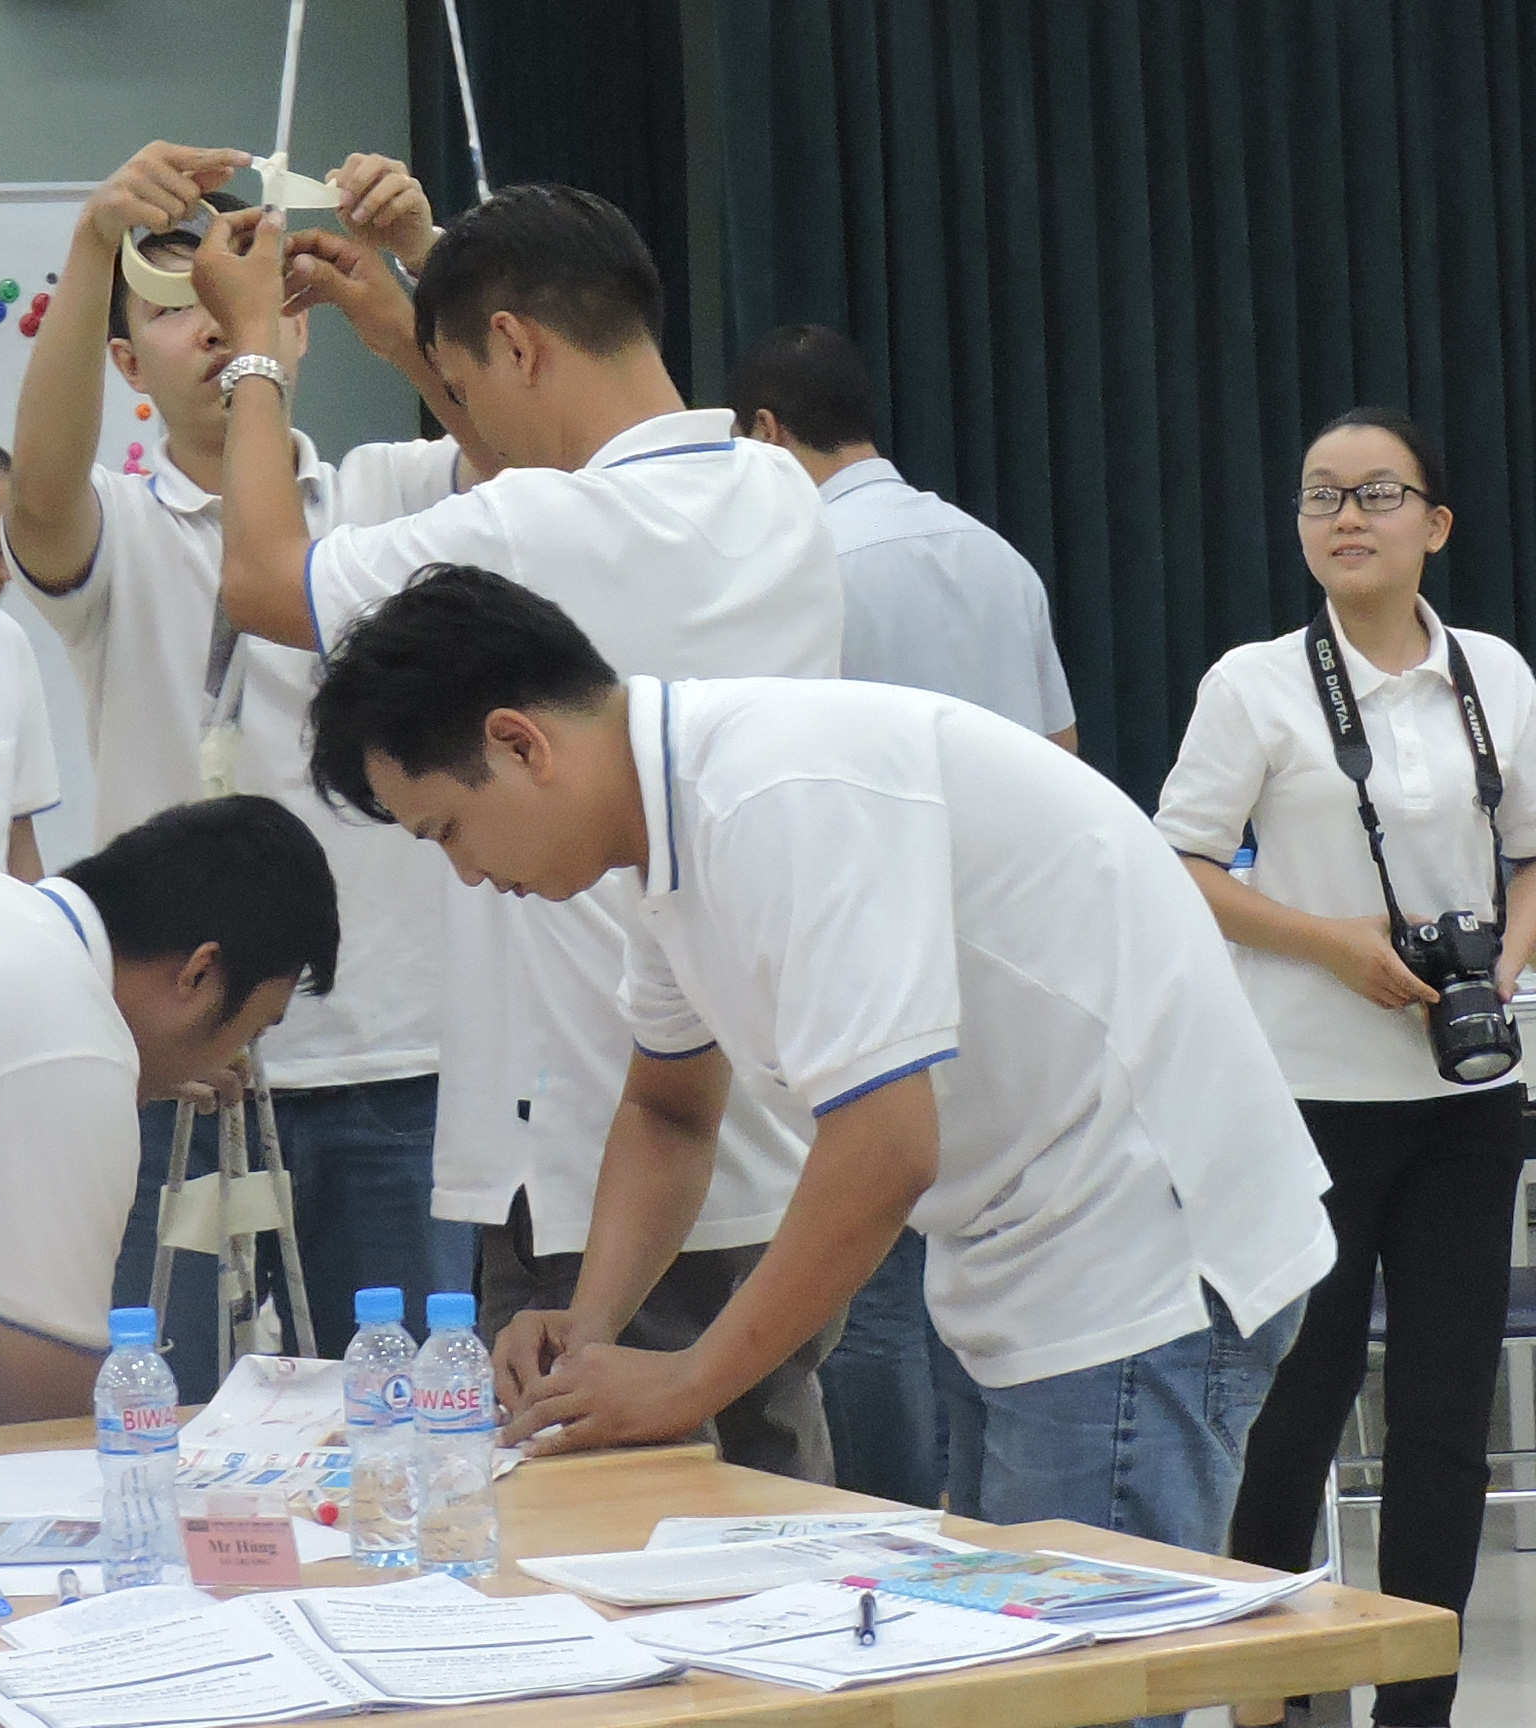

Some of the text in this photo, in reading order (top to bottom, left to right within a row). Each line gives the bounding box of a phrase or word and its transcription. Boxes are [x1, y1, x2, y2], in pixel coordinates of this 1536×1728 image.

[1316, 638, 1354, 736] EOS DIGITAL
[413, 1385, 481, 1410] IWASE
